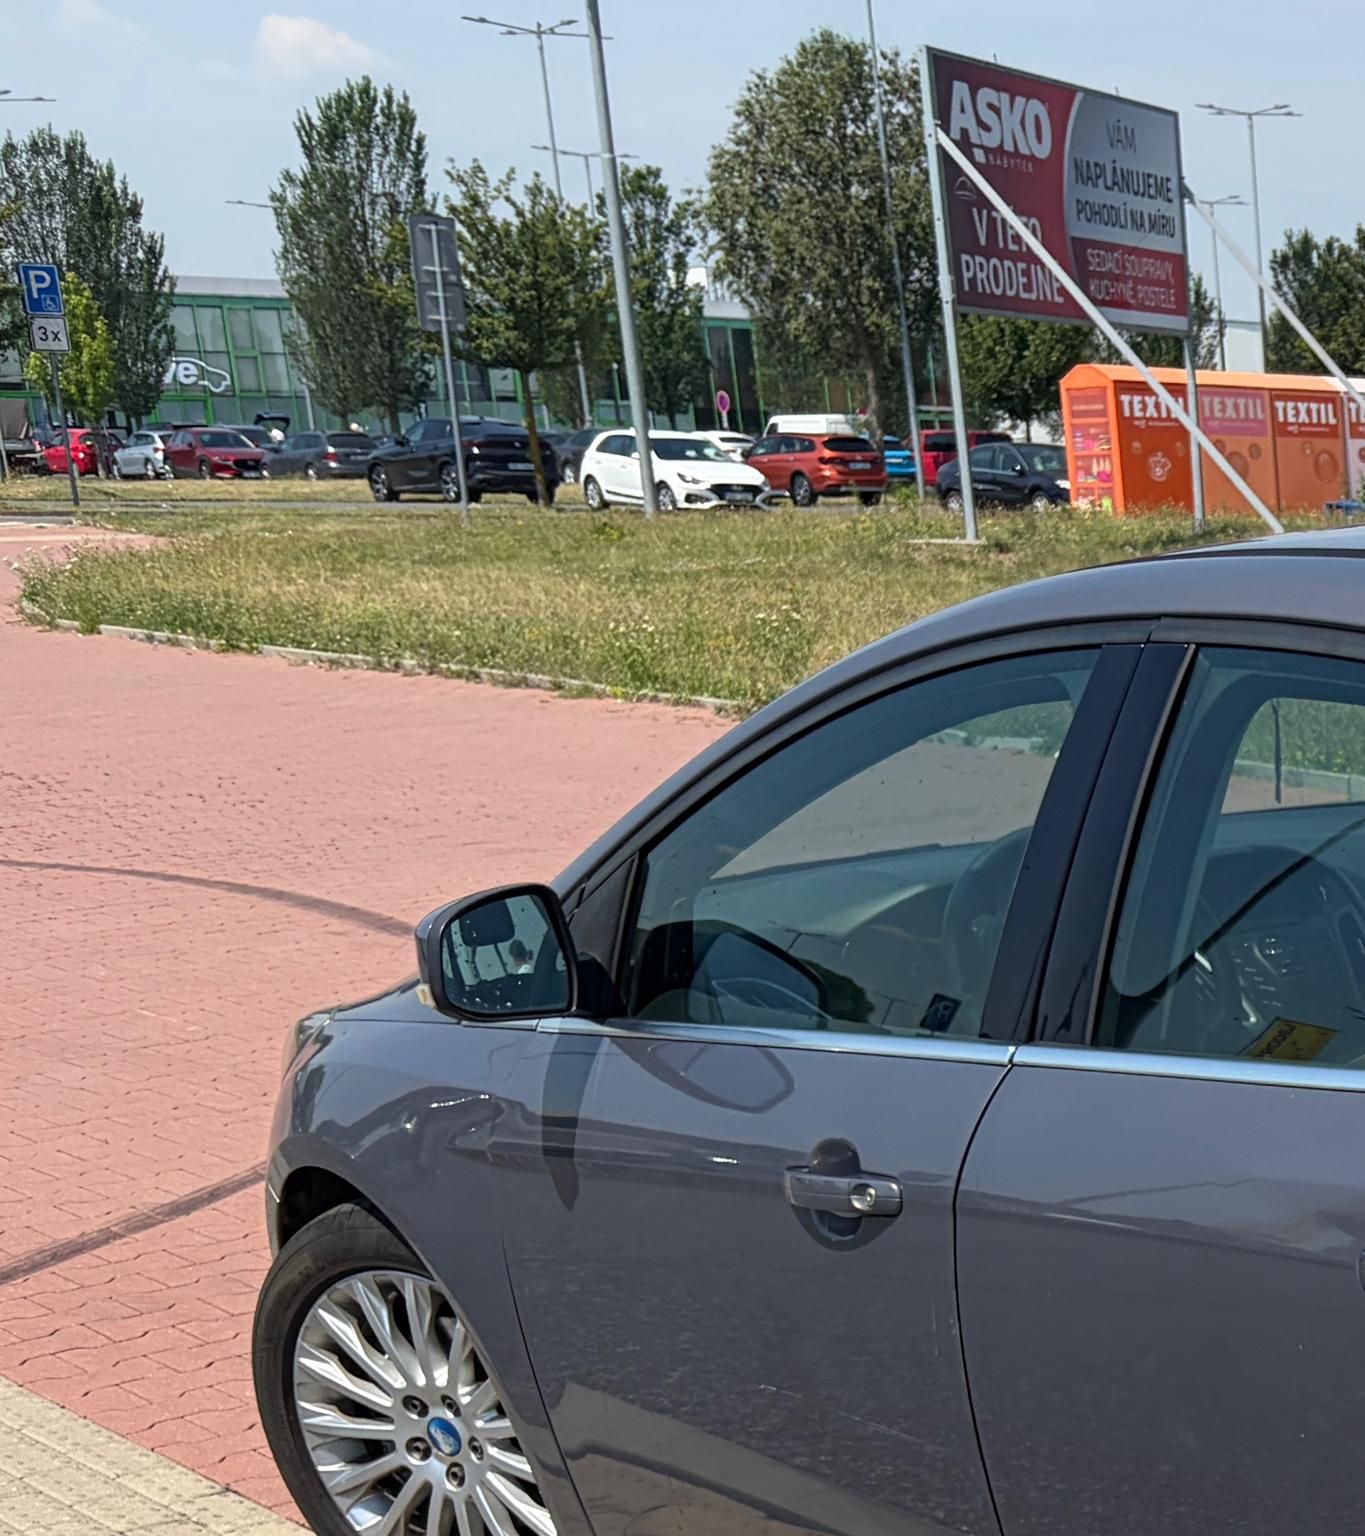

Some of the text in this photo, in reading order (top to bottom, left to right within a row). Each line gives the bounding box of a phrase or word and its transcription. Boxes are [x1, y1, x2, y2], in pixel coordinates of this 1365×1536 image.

[950, 80, 1052, 159] ASKO
[1074, 157, 1173, 203] NAPLÁNUJEME
[972, 207, 988, 246] V
[1075, 198, 1176, 238] POHODLÍ NA MÍRU
[28, 270, 51, 299] P
[1202, 395, 1265, 420] TEXTIL
[1275, 401, 1337, 425] TEXTIL
